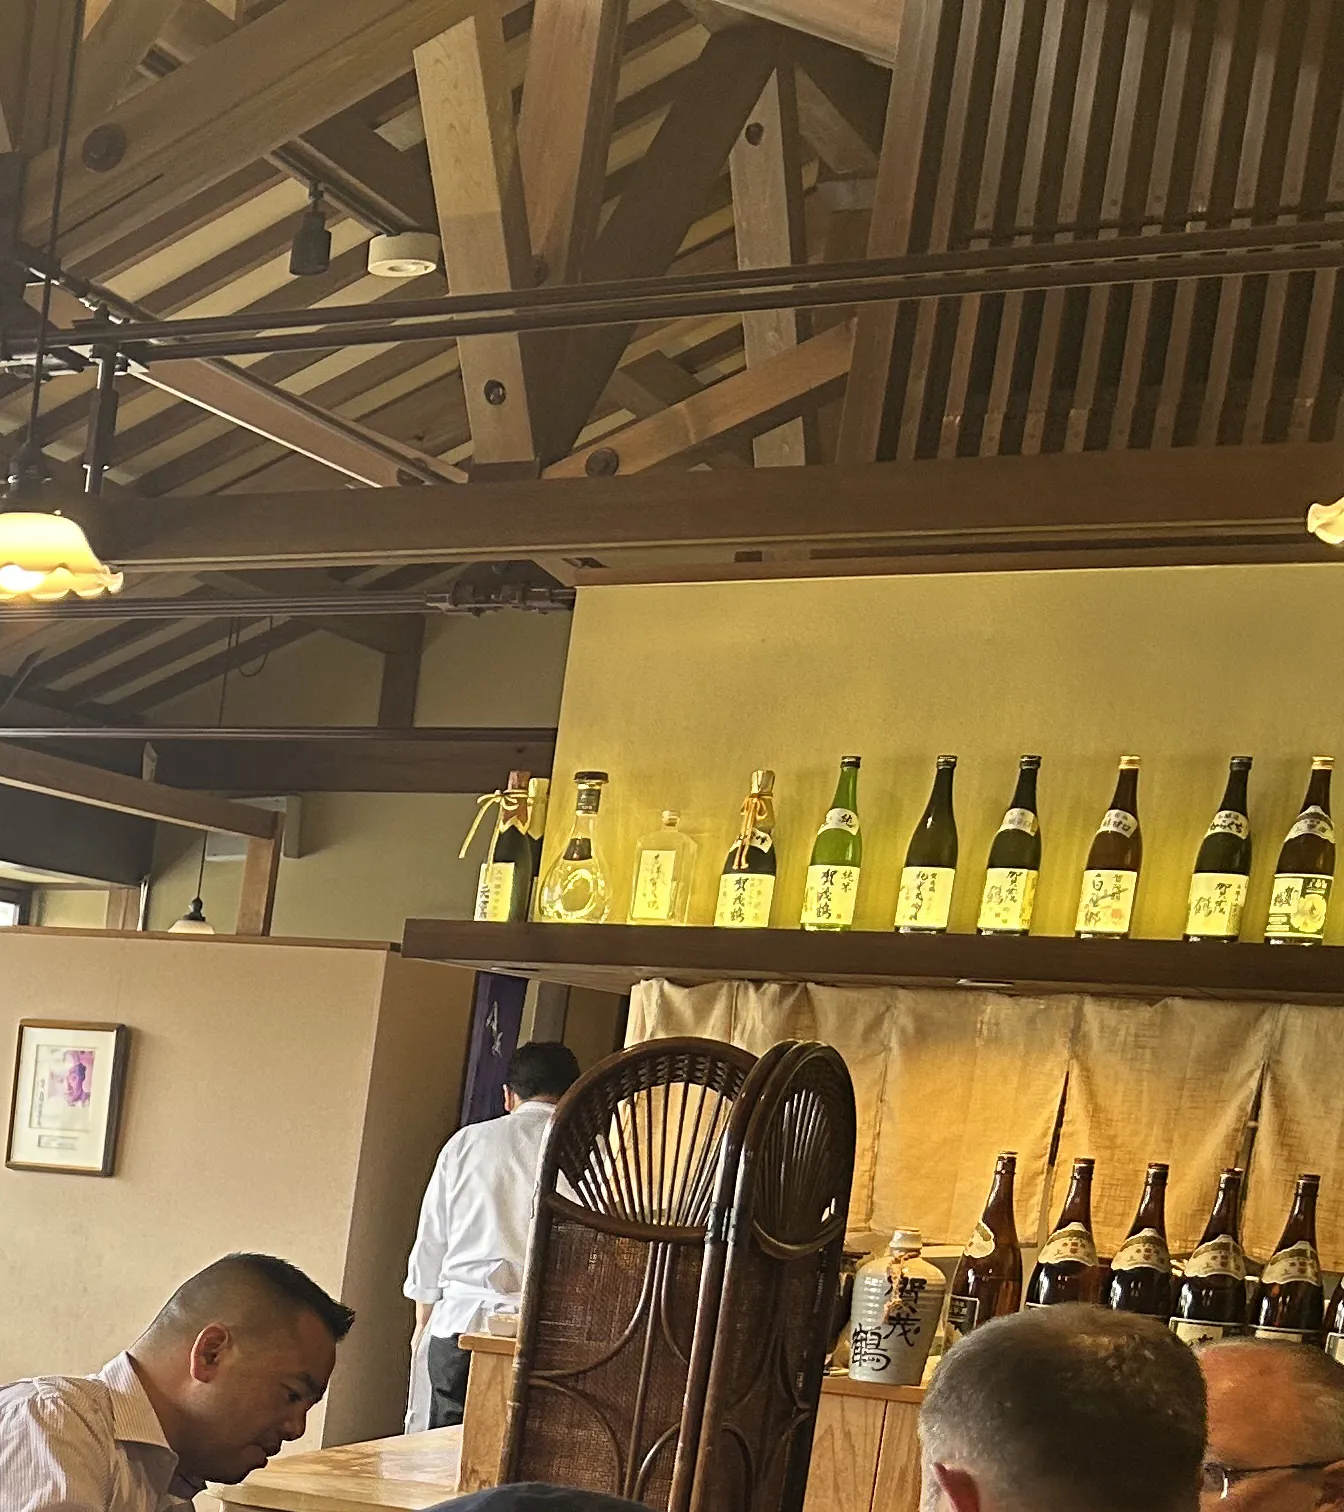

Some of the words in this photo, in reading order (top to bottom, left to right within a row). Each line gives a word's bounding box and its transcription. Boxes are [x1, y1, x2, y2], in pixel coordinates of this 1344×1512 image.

[816, 868, 838, 920] 賀茂鶴
[850, 1276, 928, 1372] 賀茂鶴
